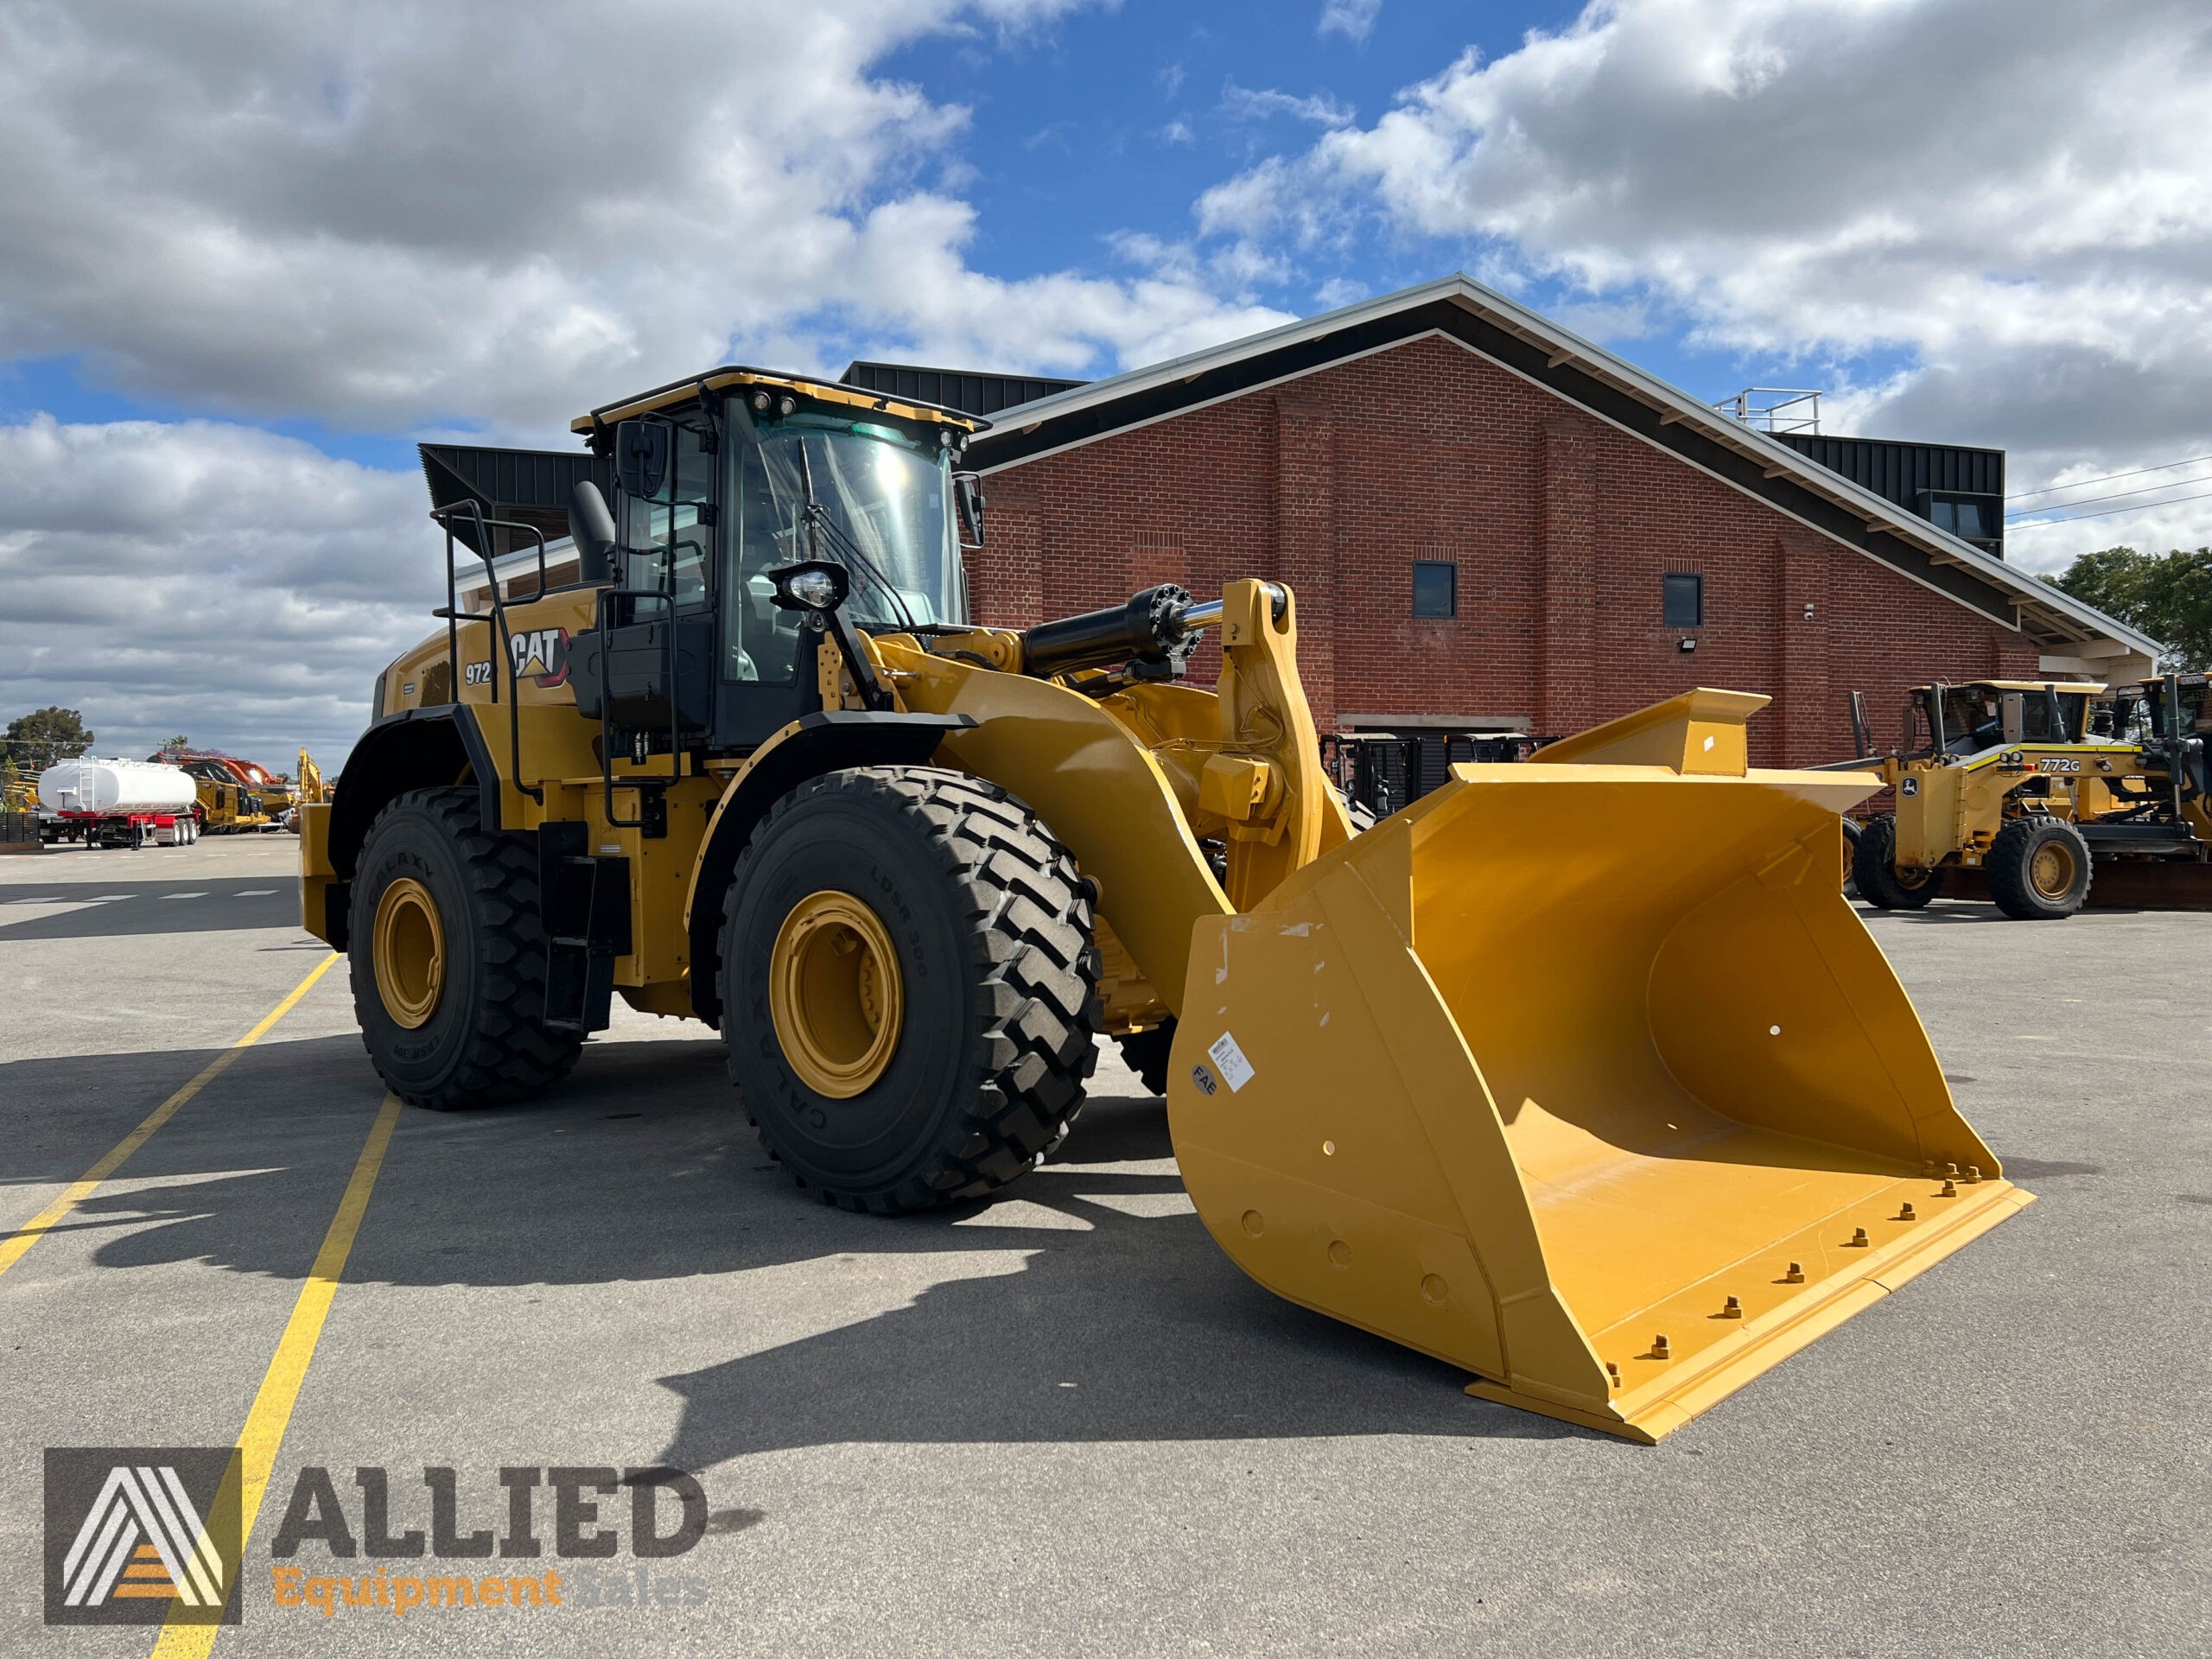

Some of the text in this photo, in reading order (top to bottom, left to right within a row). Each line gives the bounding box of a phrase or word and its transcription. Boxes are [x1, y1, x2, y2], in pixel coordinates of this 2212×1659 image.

[511, 629, 559, 678] CAT
[466, 661, 492, 685] 972
[2040, 758, 2080, 772] 772G
[1192, 1065, 1217, 1096] FAE
